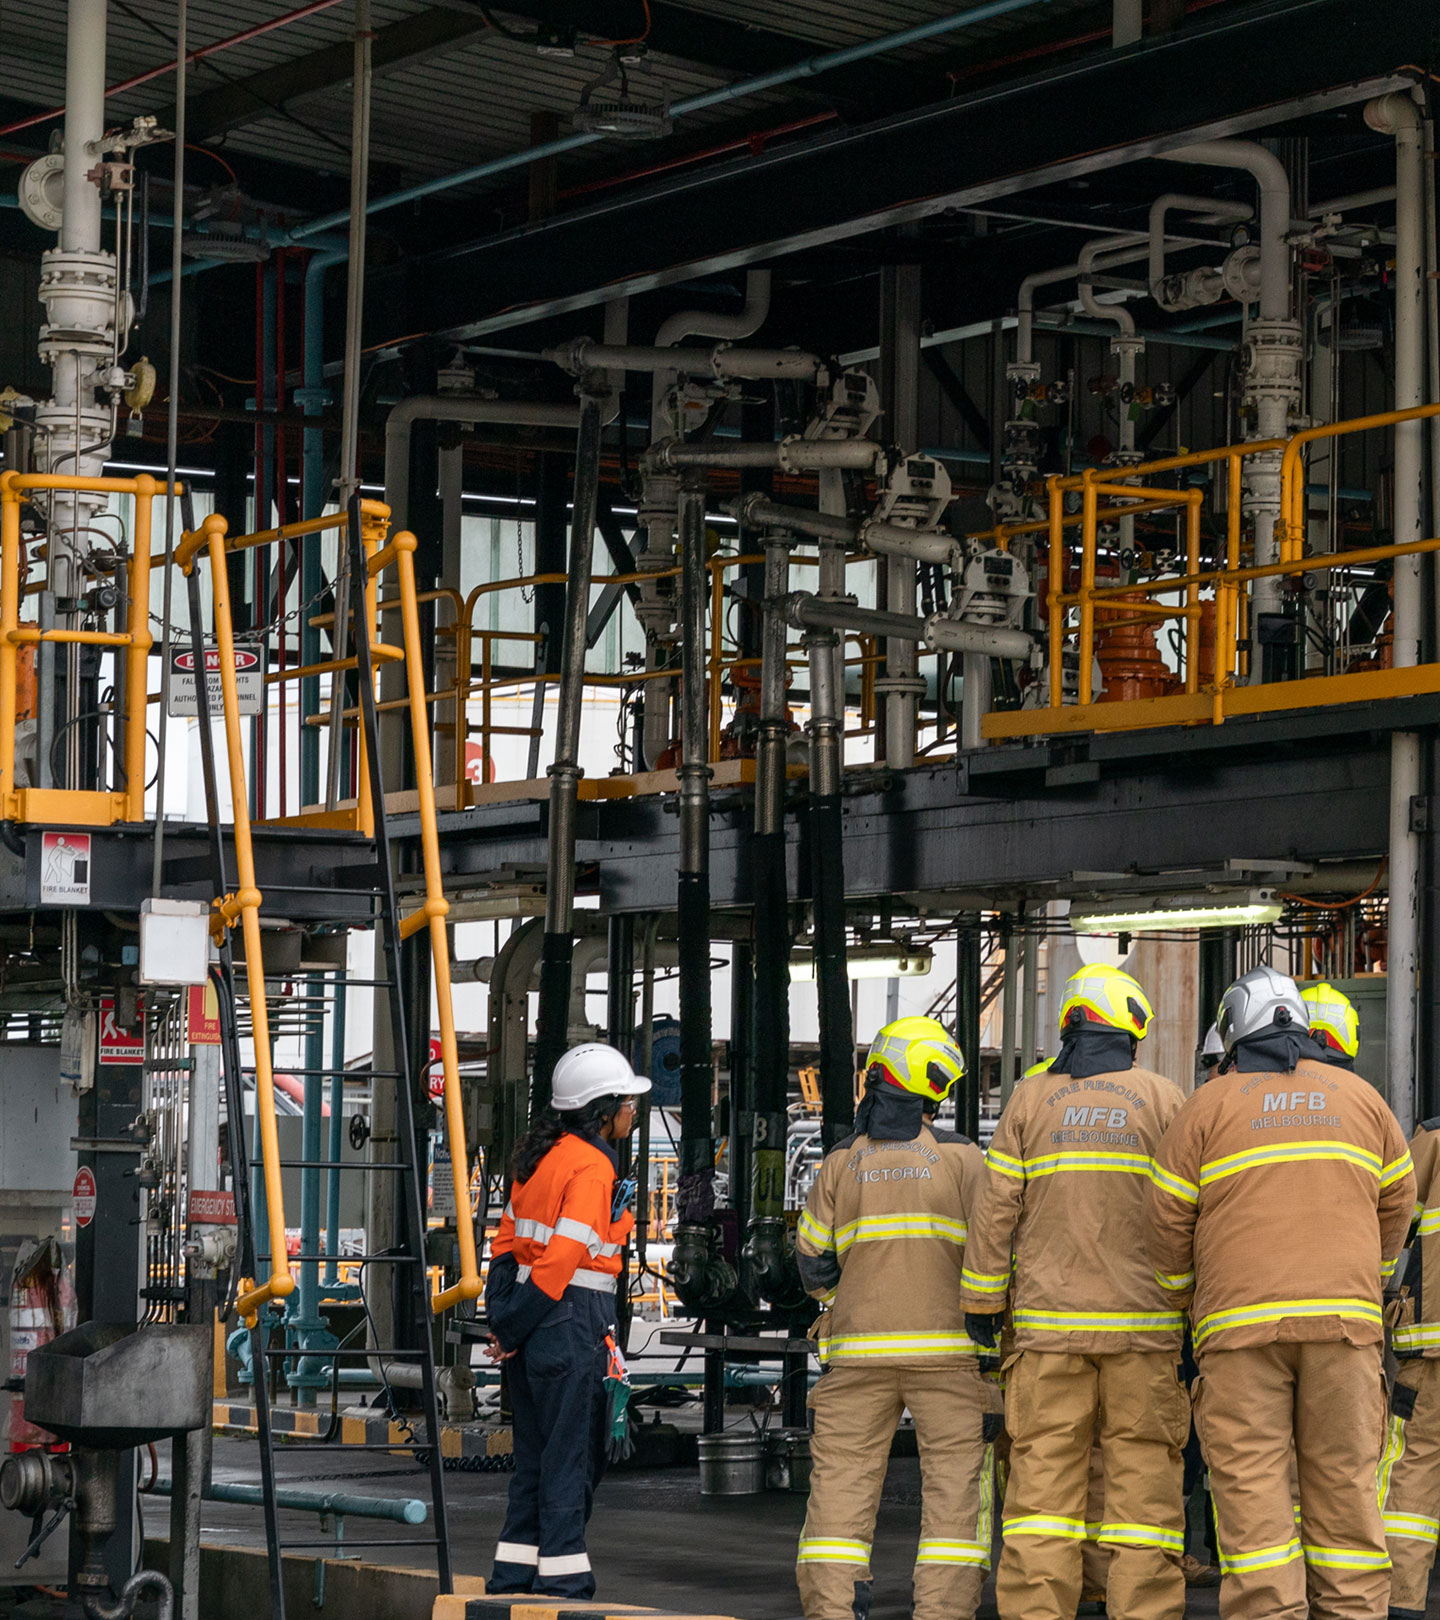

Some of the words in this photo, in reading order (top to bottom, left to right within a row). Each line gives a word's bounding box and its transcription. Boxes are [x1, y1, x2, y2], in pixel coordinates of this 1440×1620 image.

[42, 885, 57, 893] FIRE
[58, 886, 88, 894] BLANKET
[204, 1021, 216, 1031] FIRE
[100, 1047, 115, 1055] FIRE
[116, 1048, 145, 1056] BLANKET
[1046, 1081, 1081, 1107] FIRE
[1083, 1080, 1146, 1111] RESCUE
[1263, 1091, 1327, 1113] MFB
[1062, 1106, 1128, 1129] MFB
[1251, 1114, 1342, 1130] MELBOURNE
[1050, 1129, 1139, 1147] MELBOURNE
[847, 1143, 878, 1172] FIRE
[880, 1140, 941, 1166] RESCUE
[855, 1166, 932, 1184] VICTORIA
[190, 1197, 224, 1215] EMERGENCY
